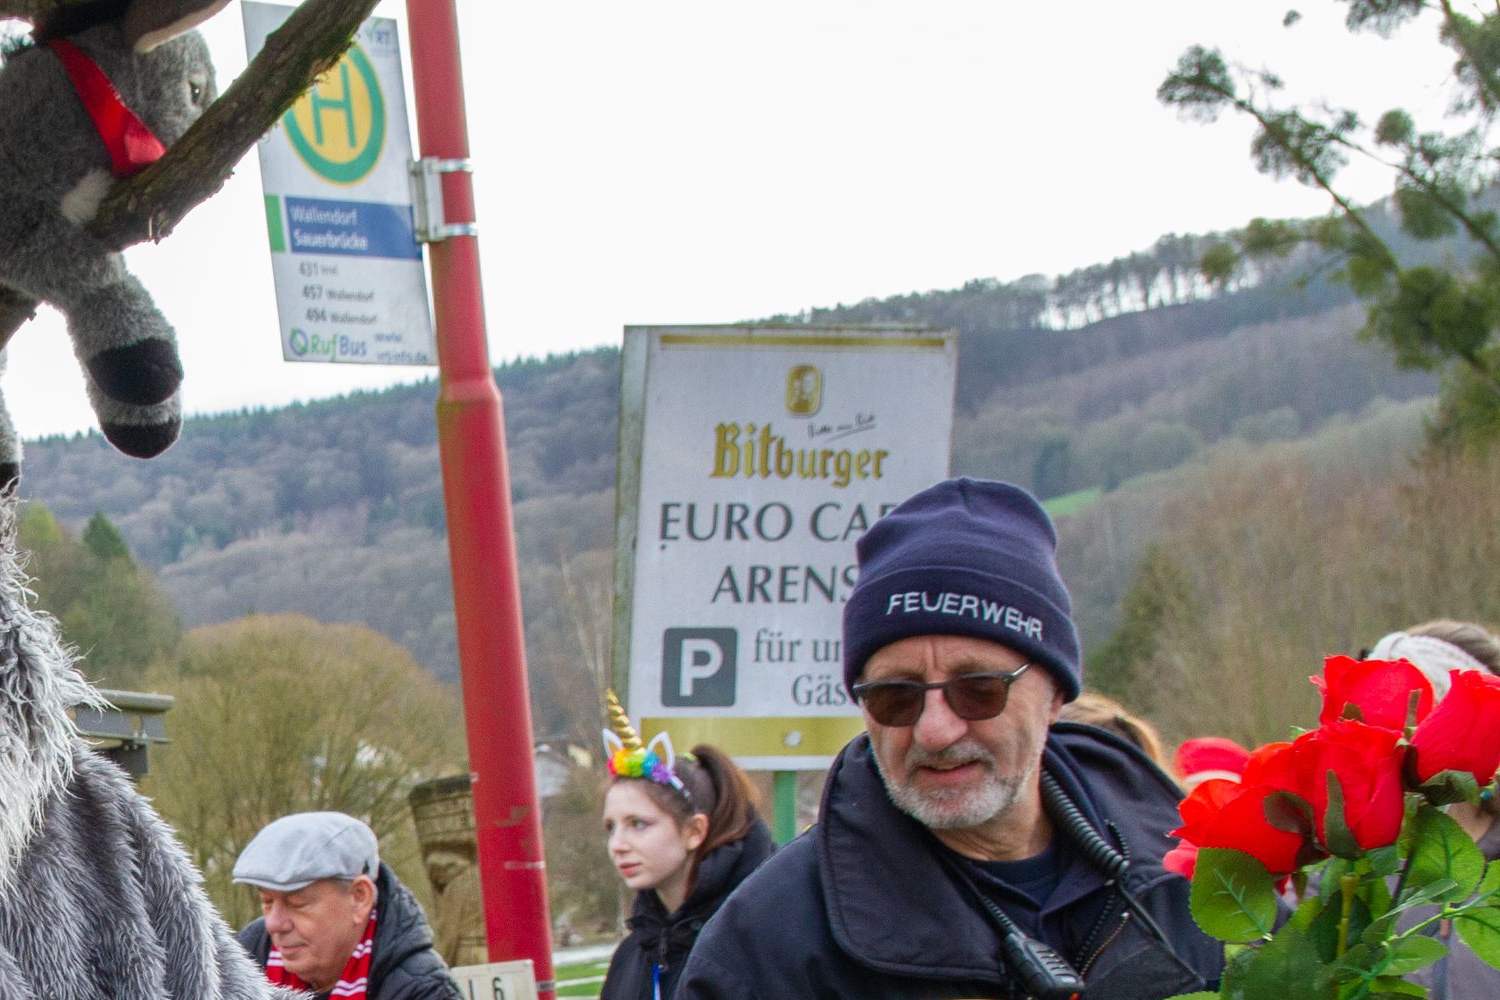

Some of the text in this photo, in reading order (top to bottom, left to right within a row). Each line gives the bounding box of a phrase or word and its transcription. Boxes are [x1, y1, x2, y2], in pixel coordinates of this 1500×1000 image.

[310, 64, 357, 149] H
[709, 422, 889, 488] Bitburger
[659, 502, 793, 542] EURO
[886, 591, 1043, 642] FEUERWEHR
[753, 627, 801, 664] für
